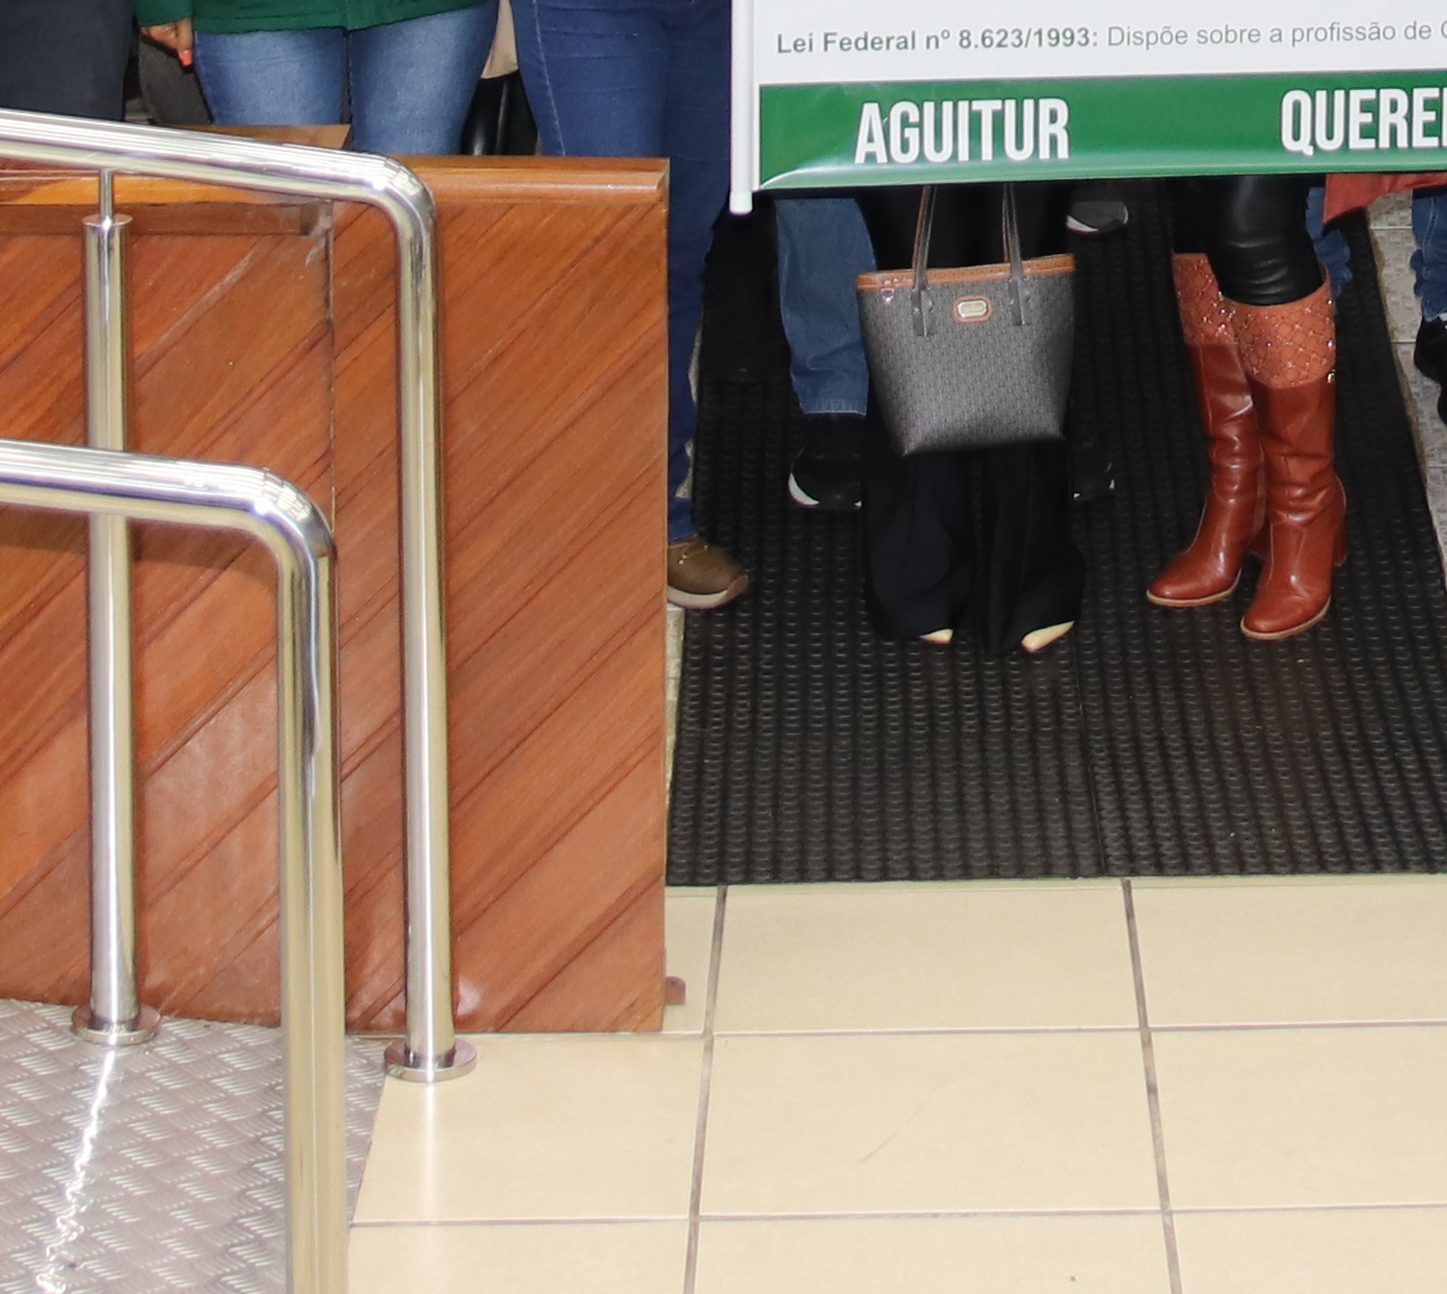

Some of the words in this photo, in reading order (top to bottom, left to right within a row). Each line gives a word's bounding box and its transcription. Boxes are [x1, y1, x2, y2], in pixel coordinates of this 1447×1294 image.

[777, 32, 814, 54] Lei
[823, 30, 916, 53] Federal
[925, 29, 951, 50] nº
[958, 26, 1098, 50] 8.623/1993:
[1107, 25, 1189, 51] Dispõe
[1196, 24, 1262, 45] sobre
[1269, 27, 1283, 43] a
[1291, 21, 1397, 48] profissão
[1403, 20, 1432, 41] de
[854, 98, 1071, 164] AGUITUR
